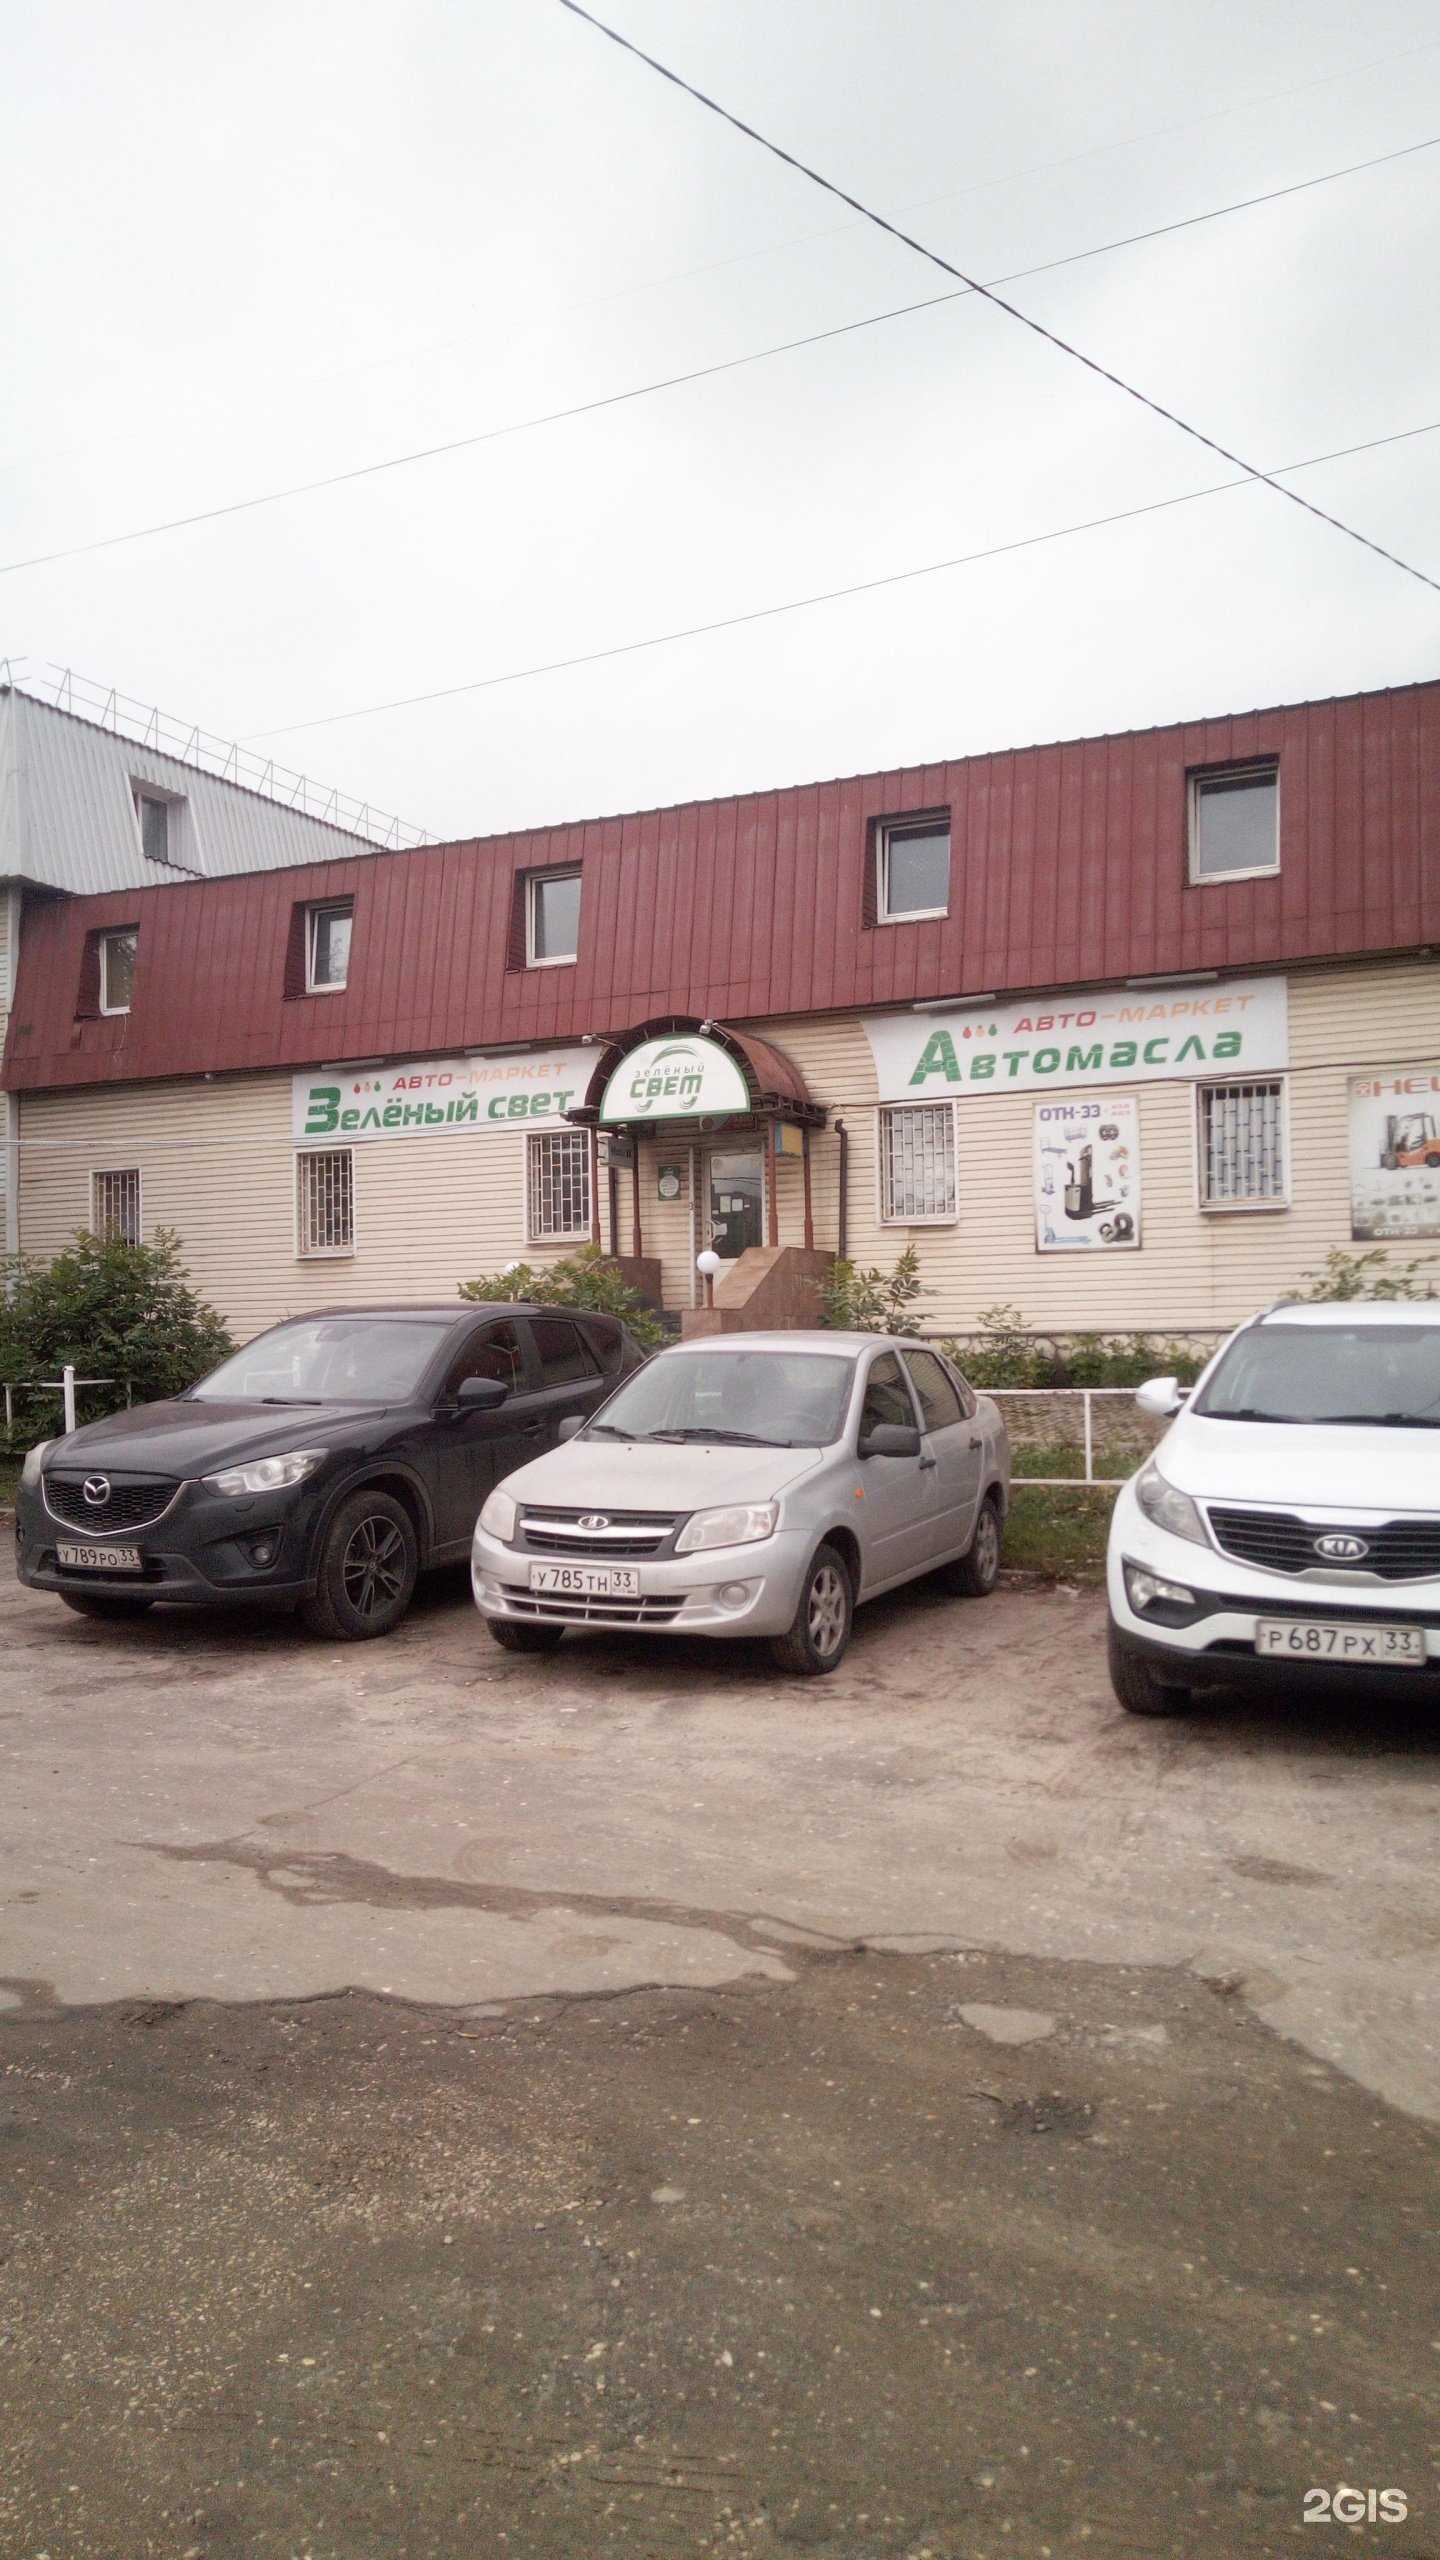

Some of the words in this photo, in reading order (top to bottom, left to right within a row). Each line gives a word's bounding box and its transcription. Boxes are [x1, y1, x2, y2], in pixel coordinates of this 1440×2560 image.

[1013, 992, 1257, 1034] АВТО-МАРКЕТ
[908, 1030, 1243, 1086] Автомасла
[392, 1062, 568, 1091] АВТО-МАРКЕТ
[304, 1086, 478, 1134] Зелёный
[1039, 1104, 1101, 1122] ОТК-33
[1322, 1540, 1359, 1555] KIA
